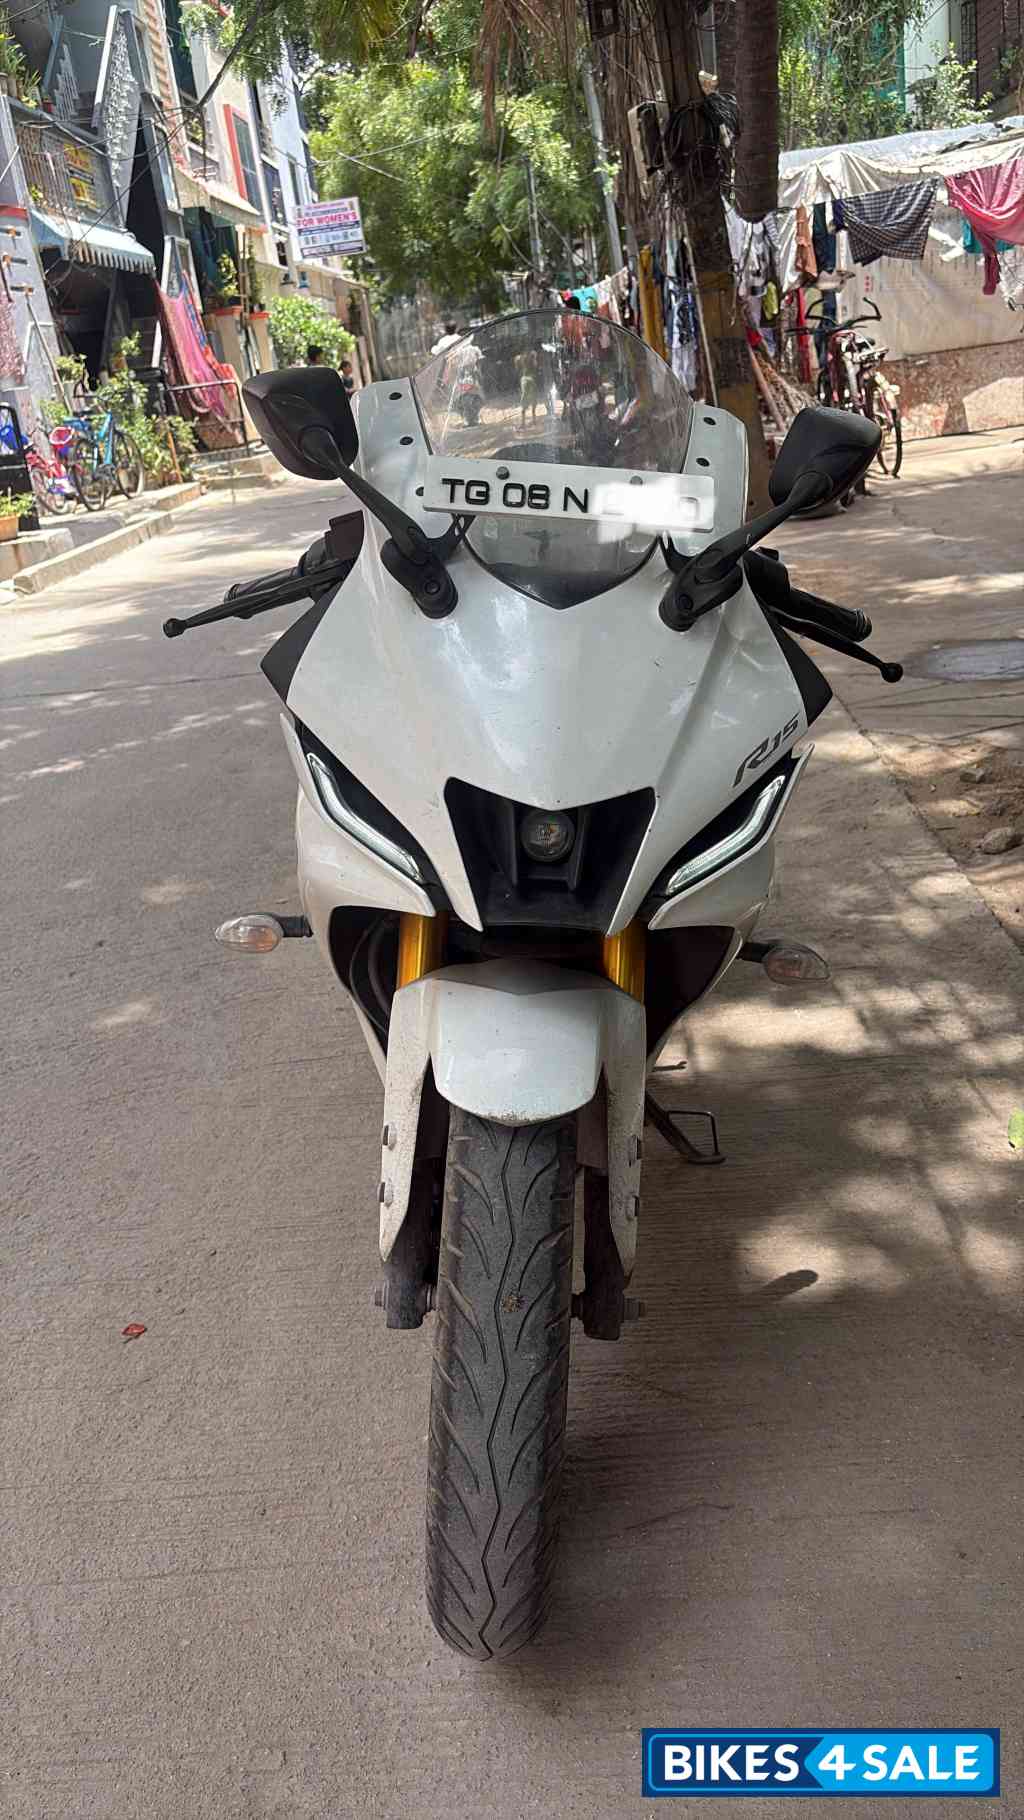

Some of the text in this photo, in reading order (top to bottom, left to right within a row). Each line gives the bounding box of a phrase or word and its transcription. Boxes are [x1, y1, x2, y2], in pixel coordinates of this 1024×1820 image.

[442, 478, 490, 506] TG
[502, 483, 550, 510] 08
[563, 487, 589, 513] N
[733, 711, 801, 788] R15
